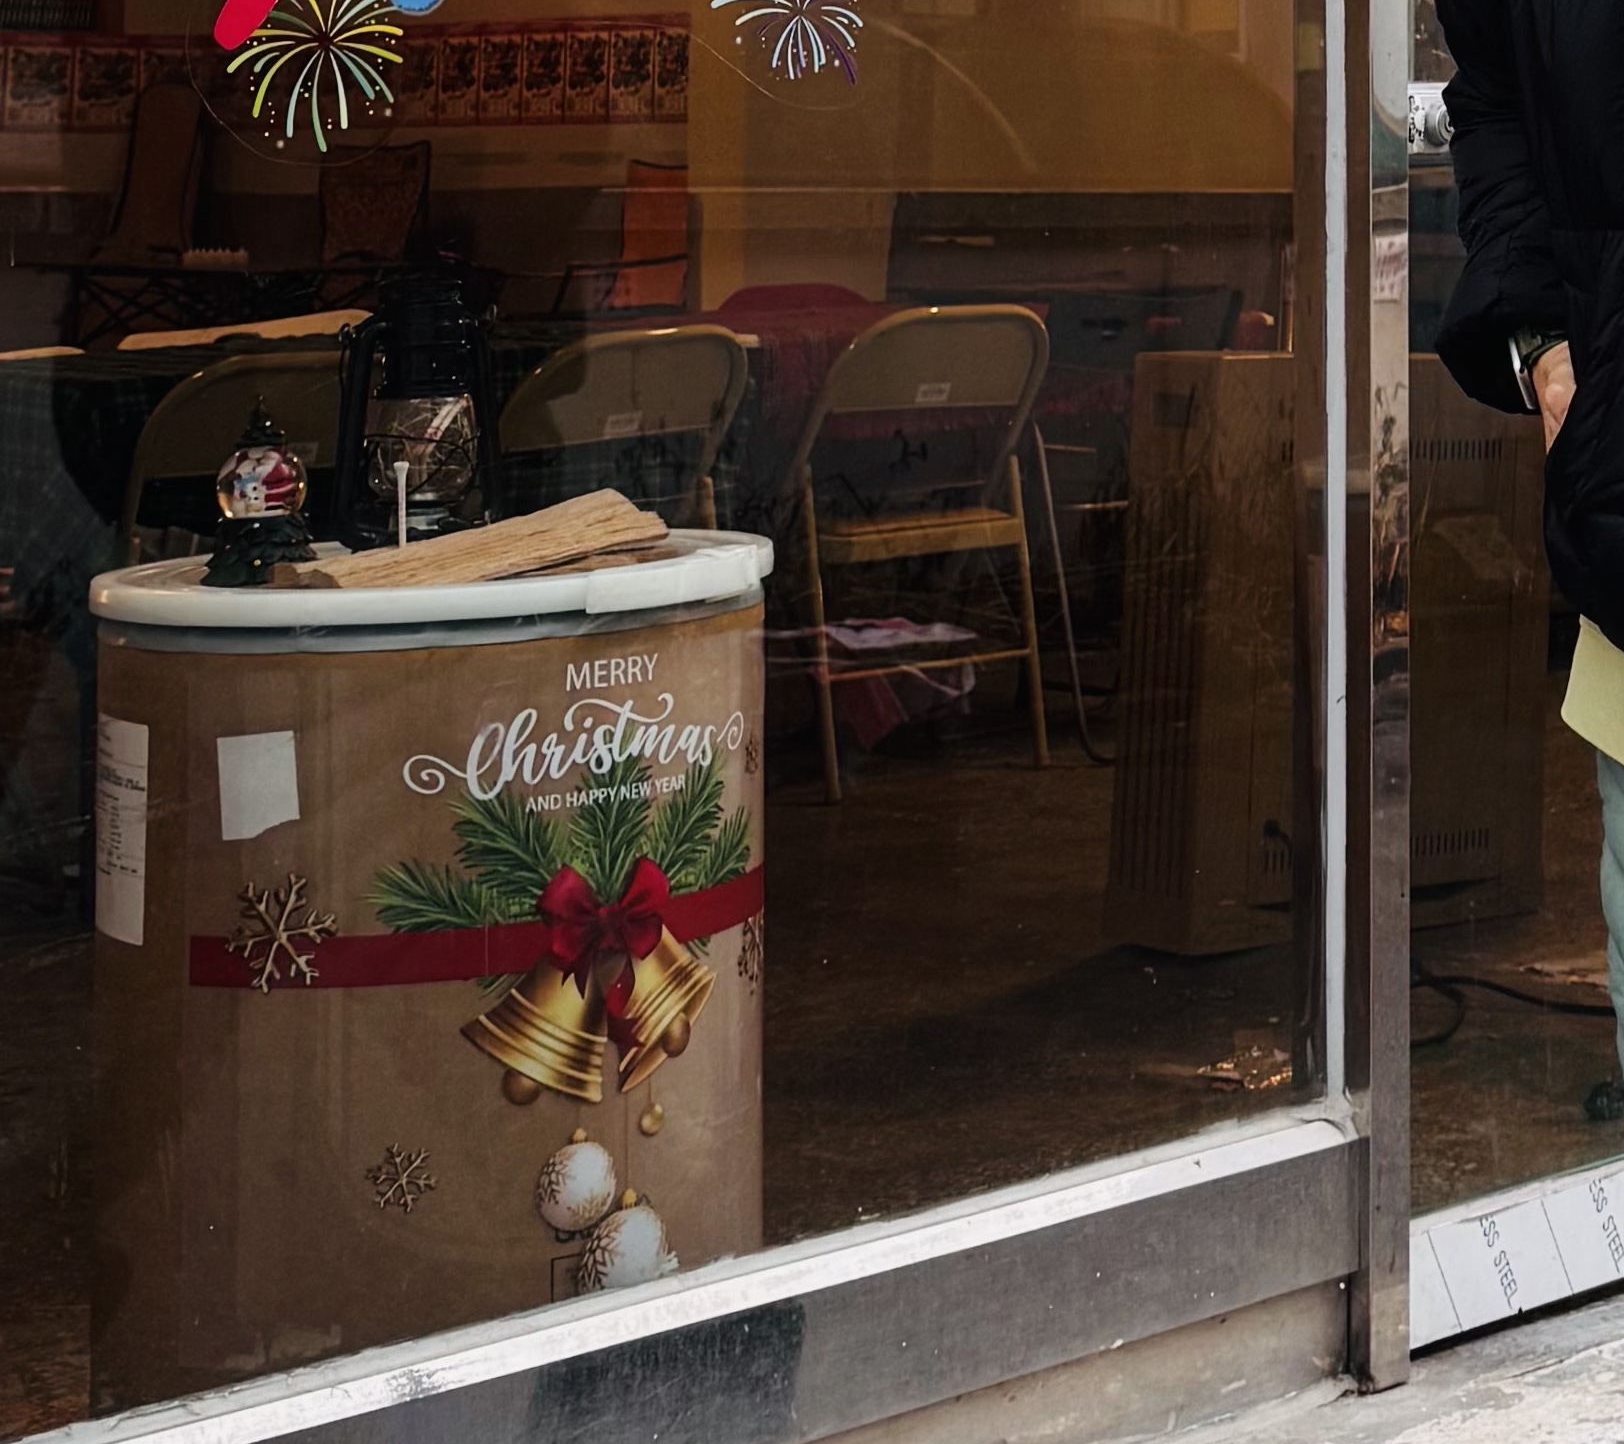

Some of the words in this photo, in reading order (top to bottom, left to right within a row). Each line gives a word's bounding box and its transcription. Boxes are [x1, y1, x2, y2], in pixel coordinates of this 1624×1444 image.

[566, 654, 659, 692] MERRY
[403, 693, 744, 801] Christmas
[525, 793, 561, 812] AND
[566, 786, 617, 808] HAPPY
[620, 780, 651, 801] NEW
[655, 774, 686, 794] YEAR
